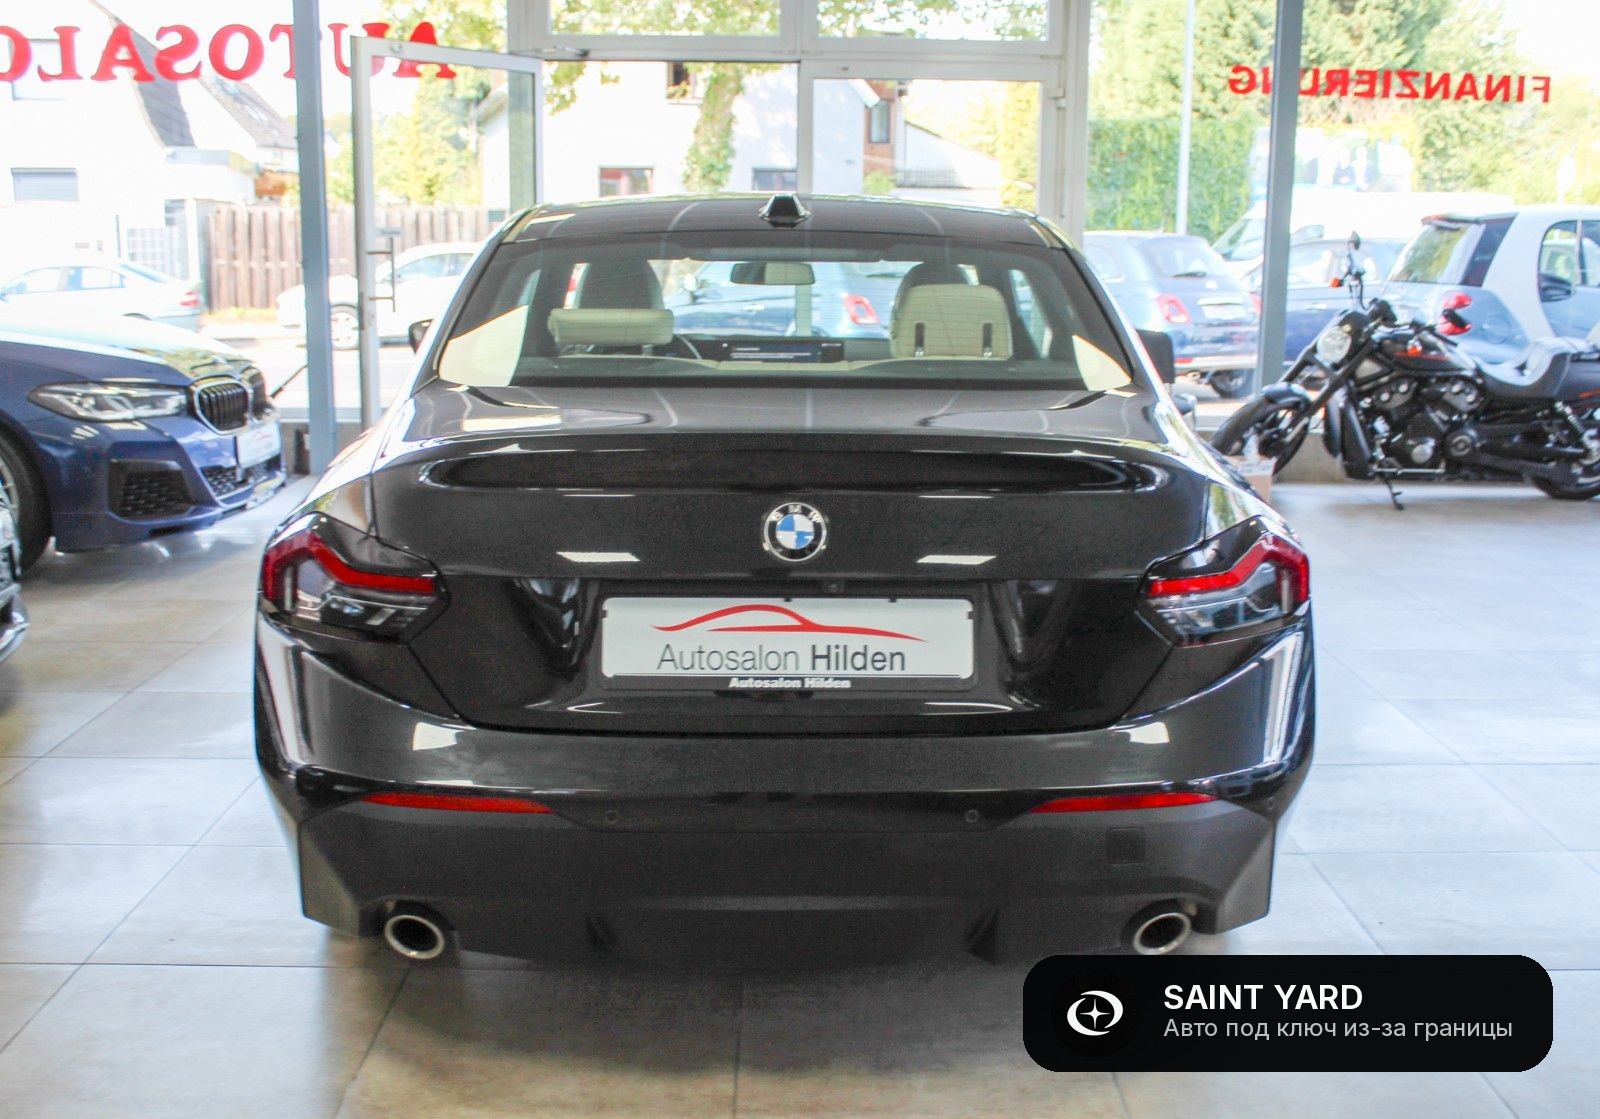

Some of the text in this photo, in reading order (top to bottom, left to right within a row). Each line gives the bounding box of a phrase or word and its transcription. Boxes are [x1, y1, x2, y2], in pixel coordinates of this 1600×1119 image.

[657, 644, 906, 672] Autosalon Hilden
[728, 677, 851, 689] Autosalon Hilden
